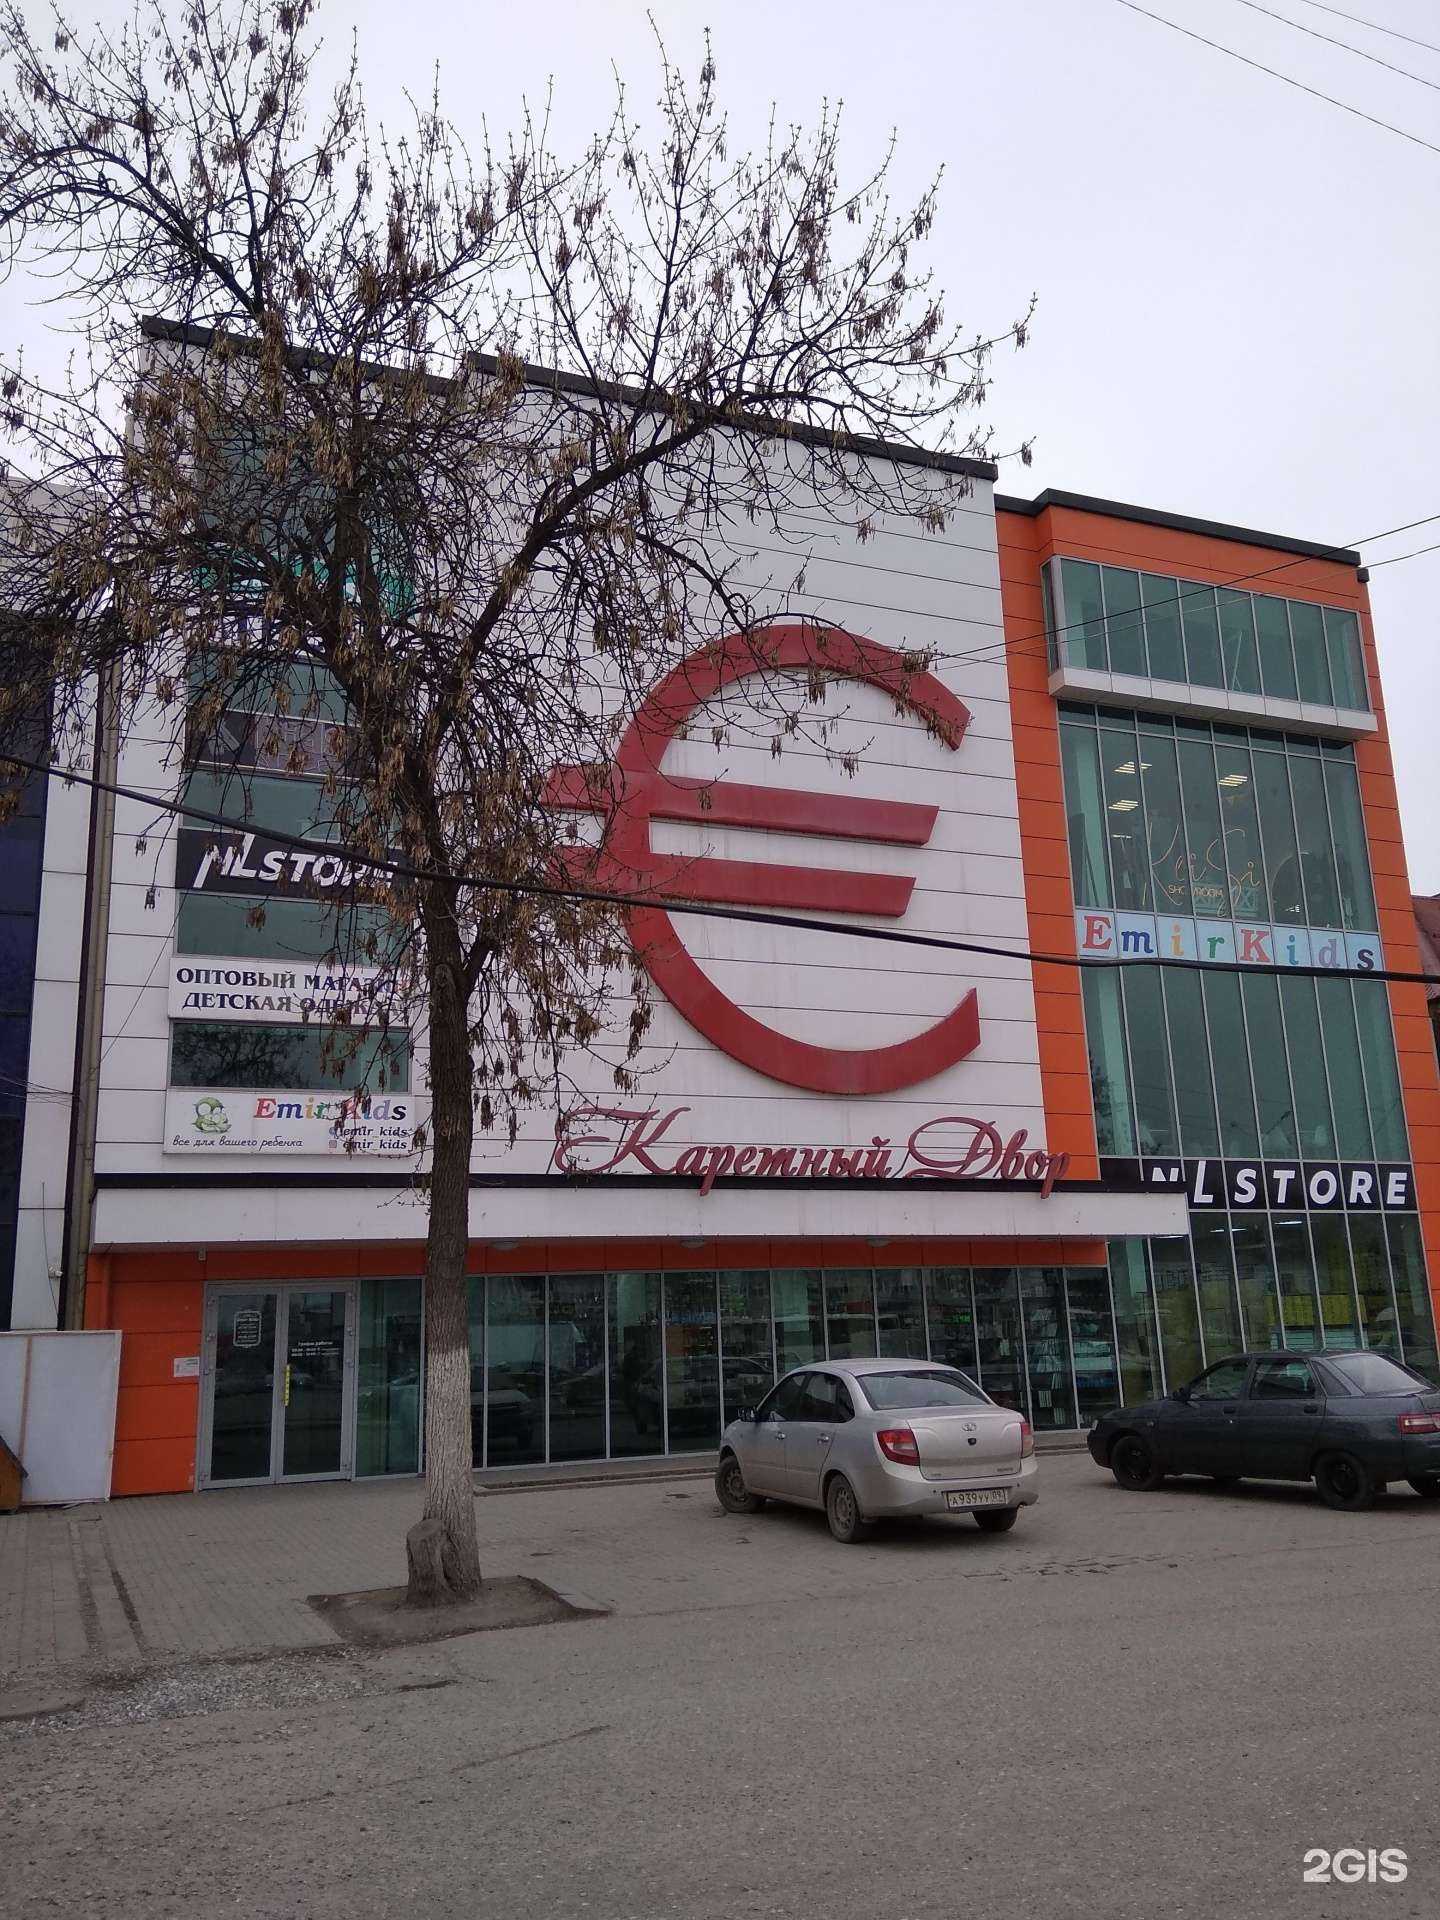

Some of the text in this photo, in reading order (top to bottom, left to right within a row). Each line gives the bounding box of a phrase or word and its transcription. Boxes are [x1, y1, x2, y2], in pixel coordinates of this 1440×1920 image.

[176, 967, 296, 989] ОПТОВЫЙ
[182, 992, 292, 1013] ДЕТСКАЯ
[172, 1134, 304, 1151] все для вашего ребенка
[555, 1106, 1071, 1199] Каретный Двор
